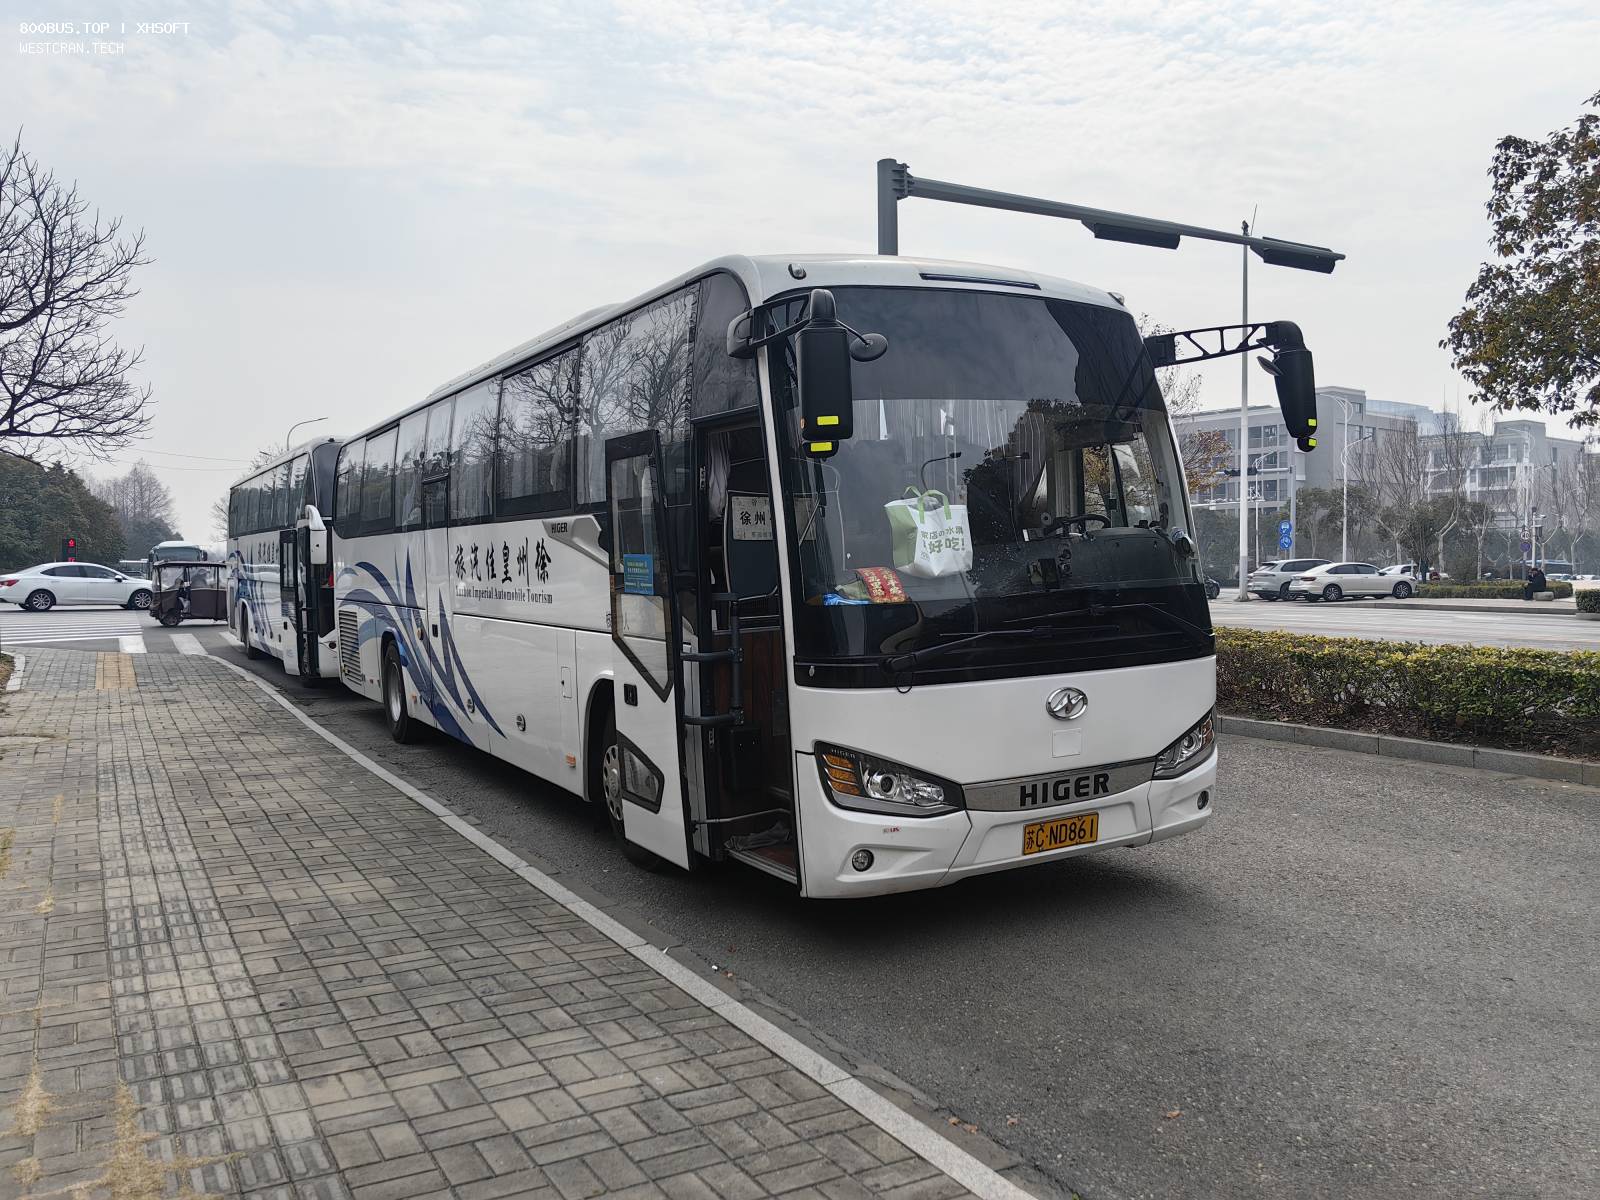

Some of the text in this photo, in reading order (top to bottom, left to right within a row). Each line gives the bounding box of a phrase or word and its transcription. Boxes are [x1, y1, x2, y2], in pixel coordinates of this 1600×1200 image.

[551, 522, 568, 534] HIGER
[527, 588, 553, 604] Tourism
[1020, 773, 1110, 807] HIGER
